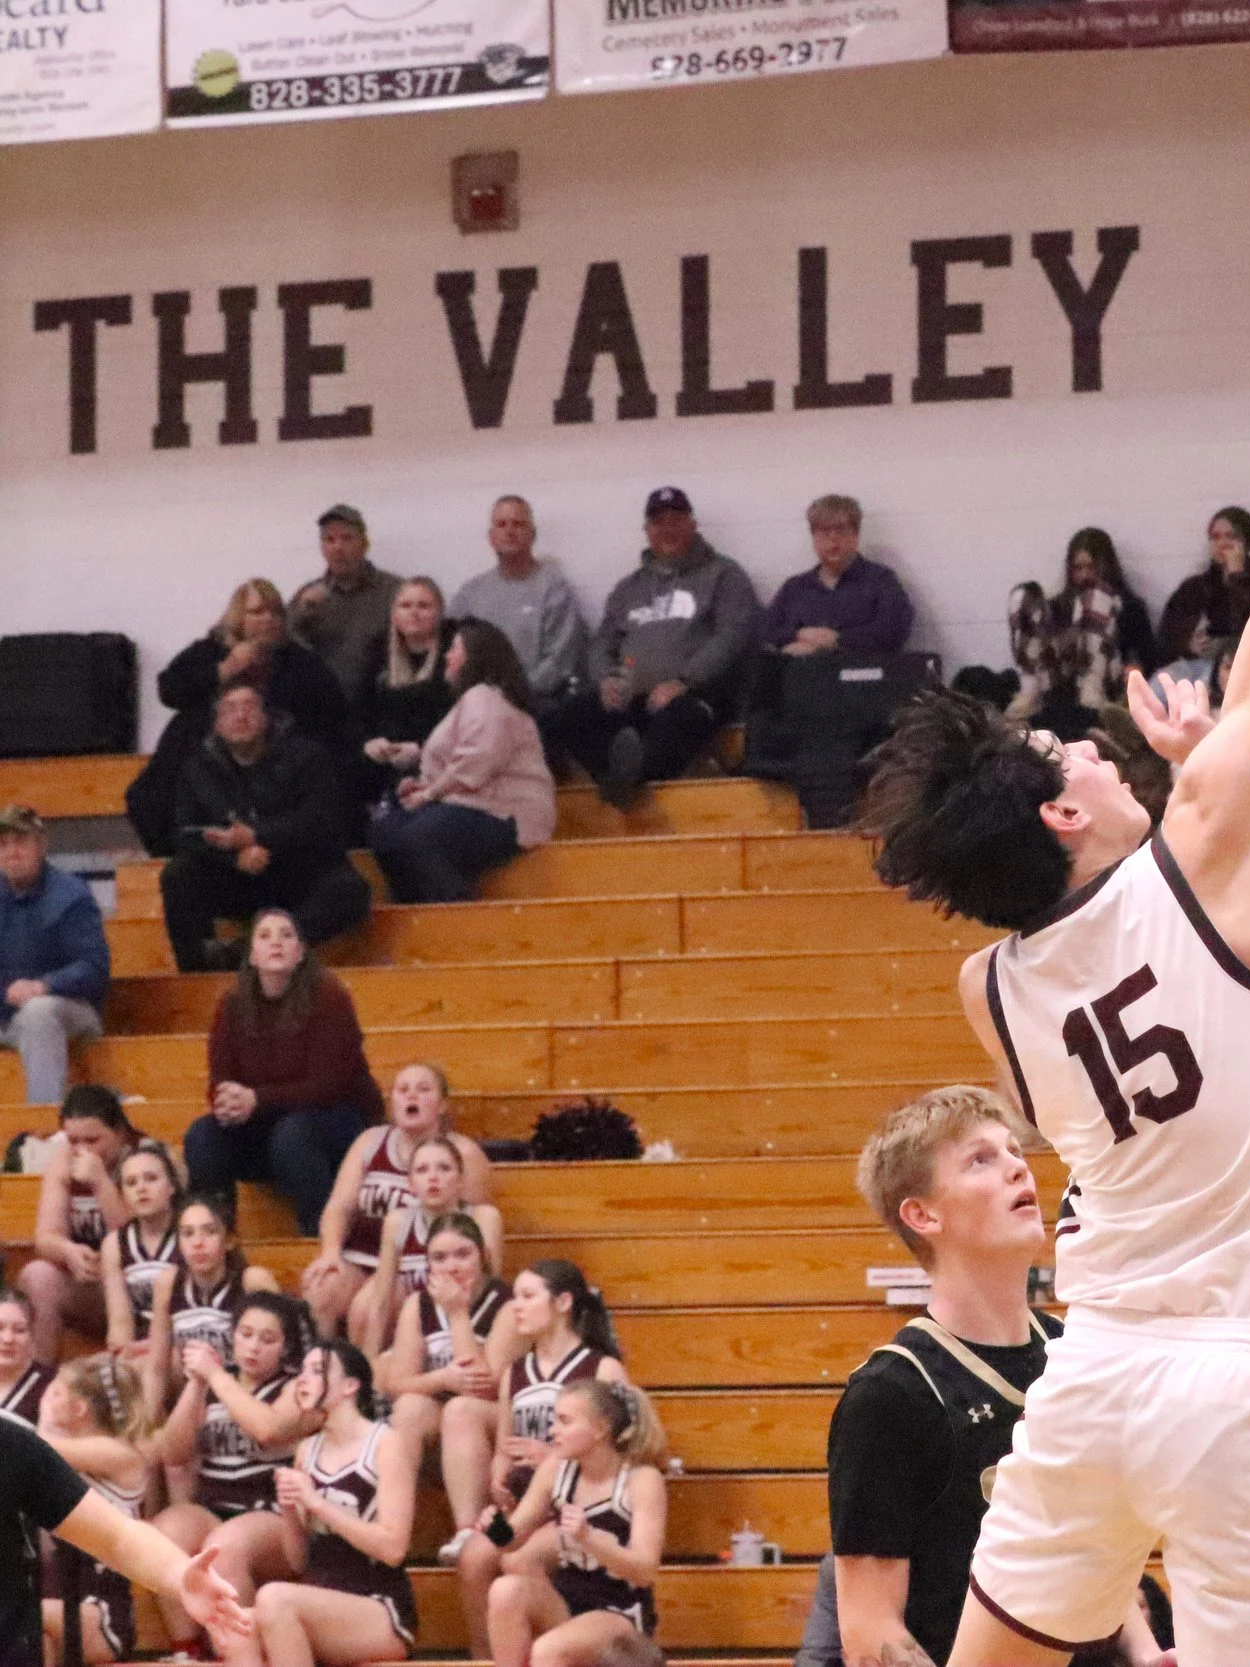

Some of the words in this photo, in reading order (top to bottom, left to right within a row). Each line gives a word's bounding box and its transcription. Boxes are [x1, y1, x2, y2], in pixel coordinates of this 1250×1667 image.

[0, 25, 69, 51] ALTY
[690, 24, 736, 44] Sales
[855, 6, 901, 22] Sales
[249, 65, 463, 112] 828-335-3777
[33, 277, 373, 455] THE
[434, 225, 1141, 430] VALLEY
[1062, 962, 1205, 1146] 15
